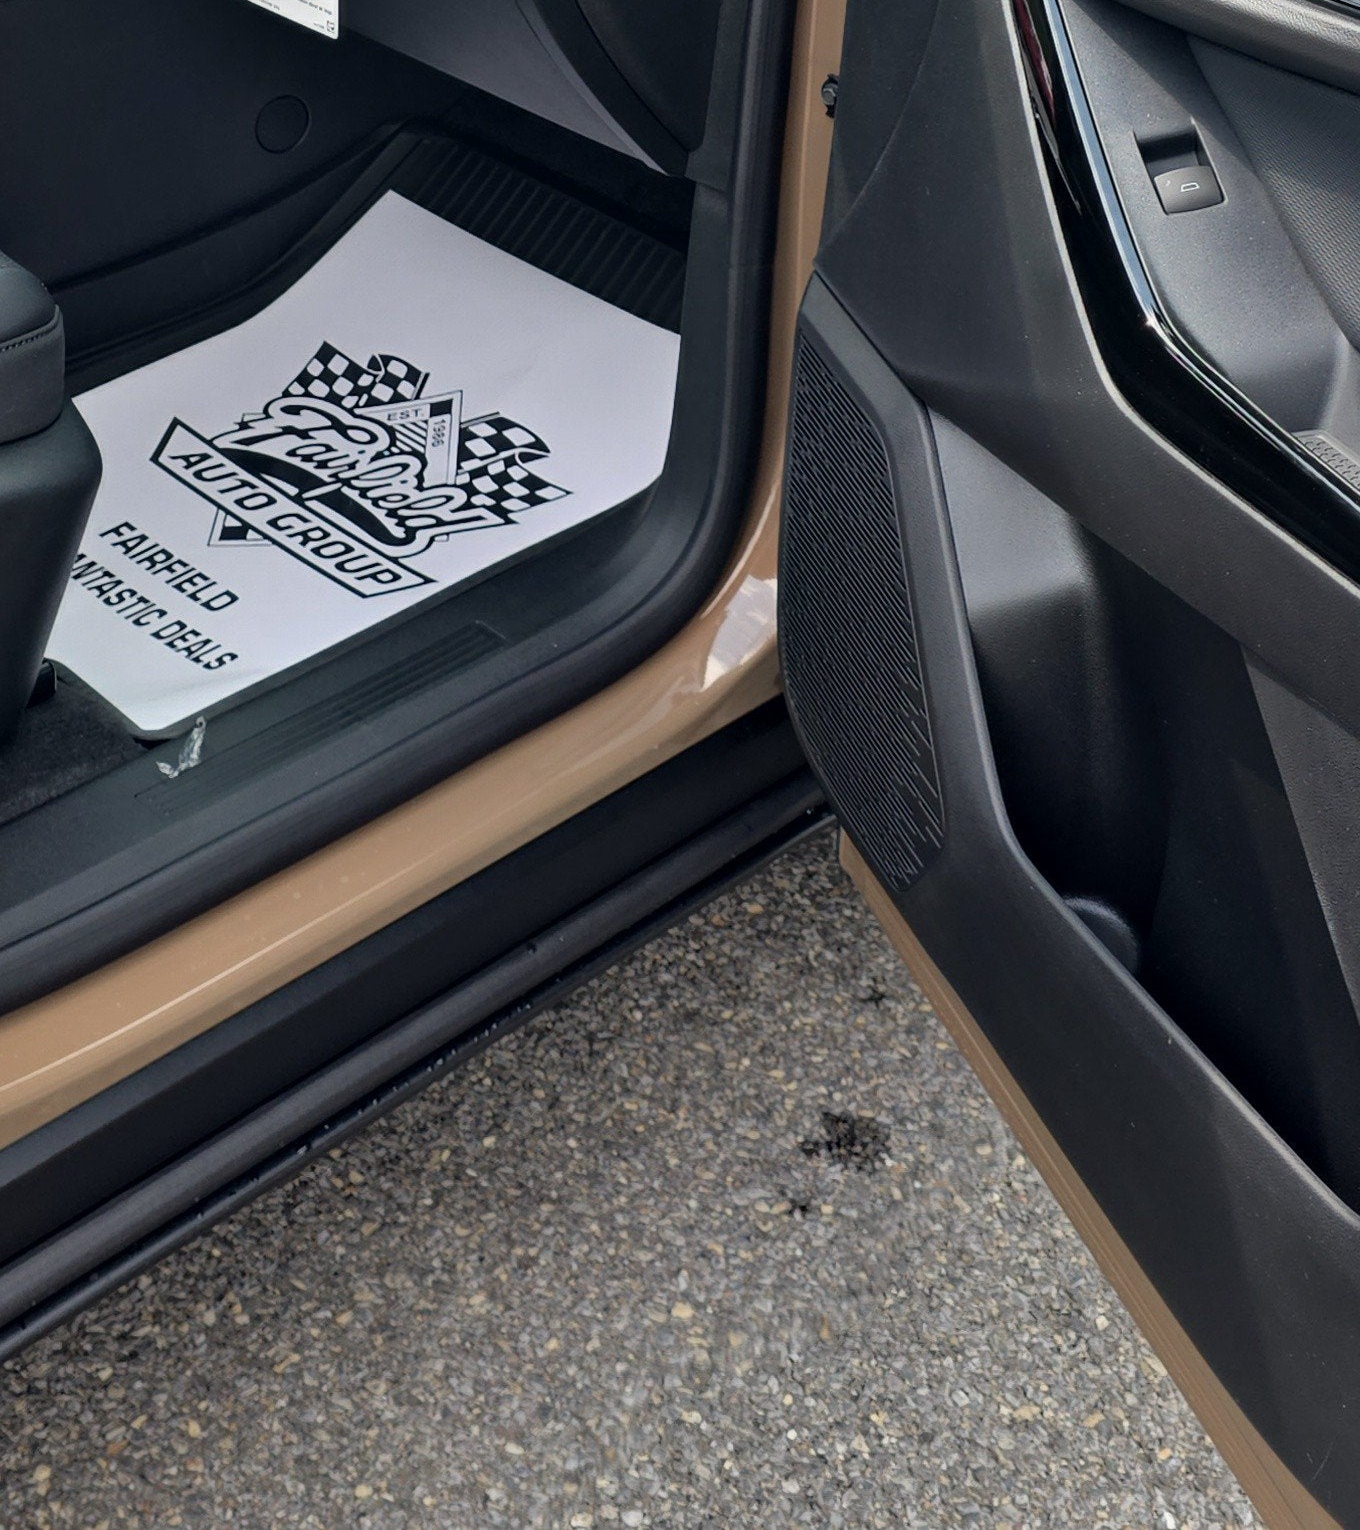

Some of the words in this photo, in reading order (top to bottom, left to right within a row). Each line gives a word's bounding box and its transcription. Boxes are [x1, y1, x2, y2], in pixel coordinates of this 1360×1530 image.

[168, 451, 278, 511] AUTO
[265, 514, 403, 585] GROUP
[212, 395, 508, 548] Fairfield
[98, 521, 240, 612] FAIRFIELD
[149, 619, 239, 670] DEALS
